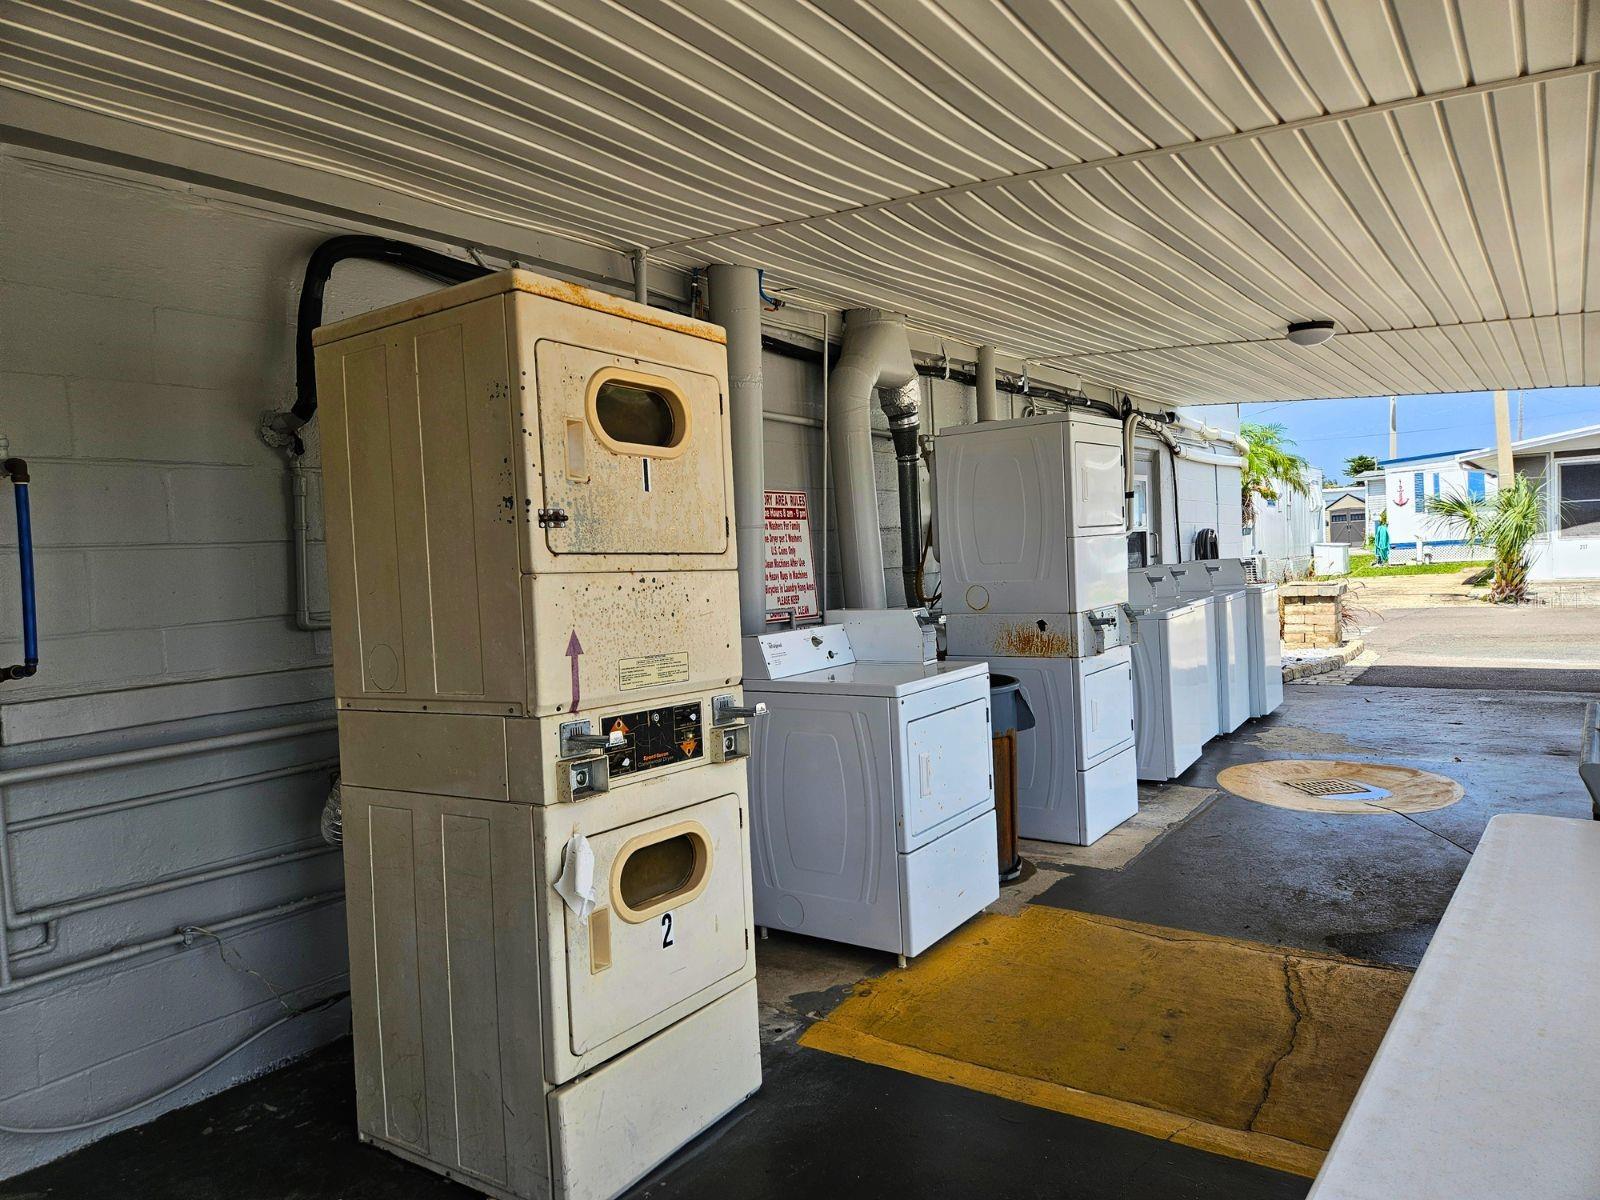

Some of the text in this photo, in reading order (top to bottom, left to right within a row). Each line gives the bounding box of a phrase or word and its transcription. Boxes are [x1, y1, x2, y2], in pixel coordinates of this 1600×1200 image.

[775, 495, 788, 506] AREA
[790, 496, 806, 506] RULES
[770, 509, 783, 518] Hours
[768, 521, 783, 530] Washers
[789, 521, 801, 532] Family
[769, 534, 779, 546] Dryer
[788, 534, 802, 542] Washers
[778, 546, 788, 555] Coins
[788, 545, 796, 557] Only
[774, 558, 790, 568] Machines
[790, 558, 799, 567] After
[769, 572, 780, 582] Heavy
[793, 571, 808, 579] Machines
[784, 584, 797, 594] Laundry
[777, 594, 800, 606] PLEASE KEEP
[798, 605, 809, 615] CLEAN
[661, 913, 673, 949] 2
